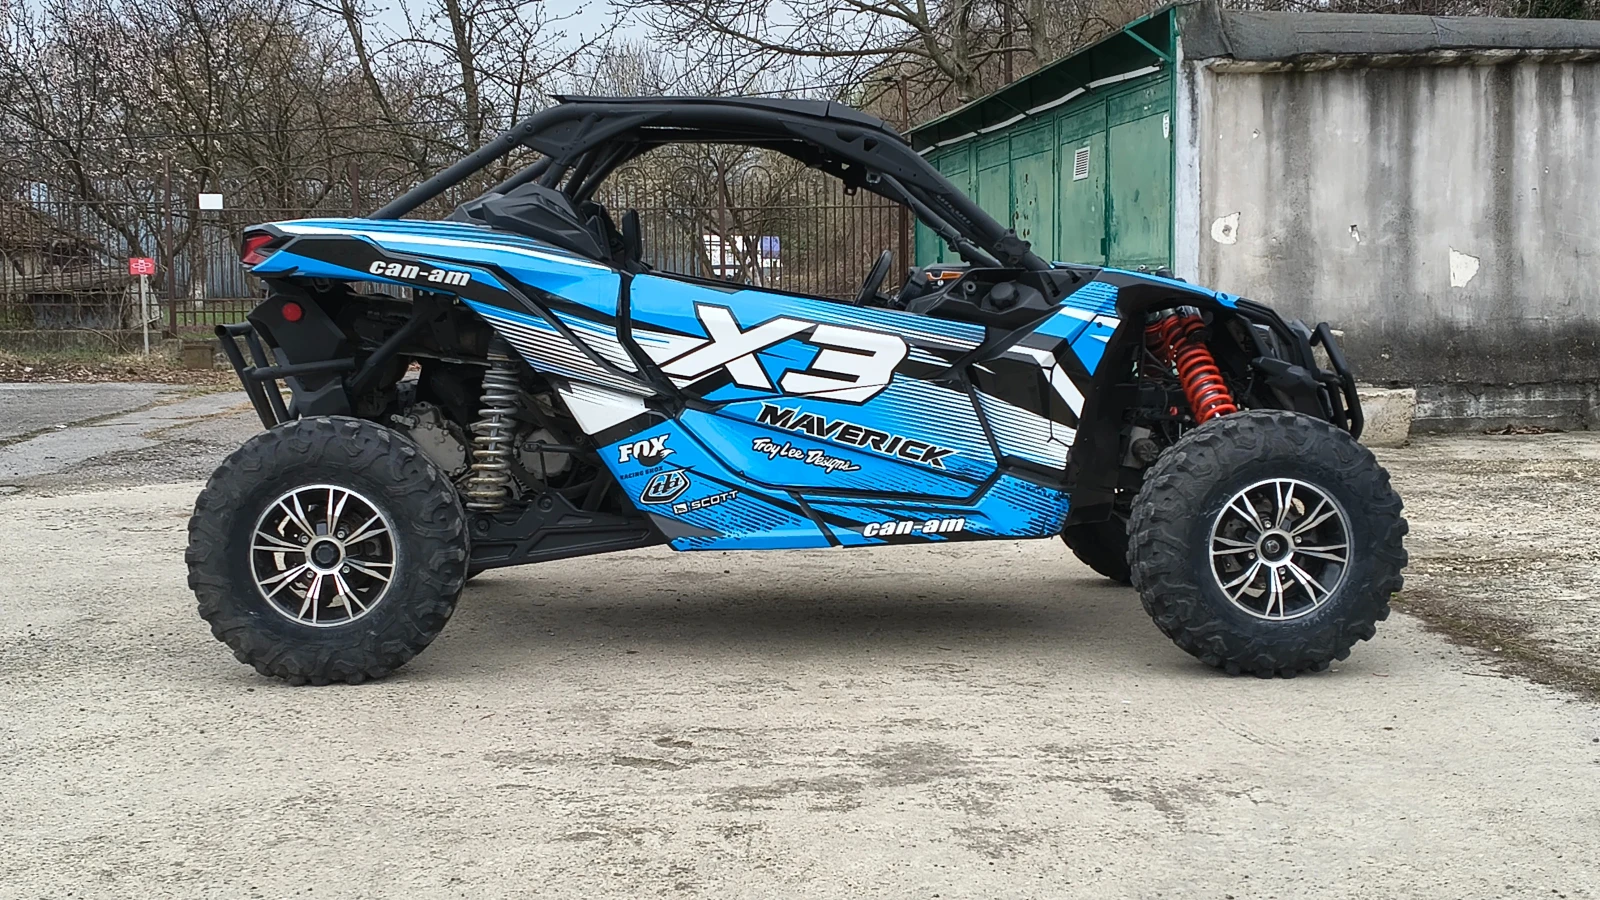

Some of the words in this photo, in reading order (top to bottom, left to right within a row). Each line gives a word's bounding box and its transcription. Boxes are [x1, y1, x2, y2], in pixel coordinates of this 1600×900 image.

[368, 260, 471, 287] can-am
[659, 302, 908, 404] X3
[618, 434, 674, 463] FOX
[755, 402, 957, 469] MAVERICK
[752, 438, 780, 460] Troy
[780, 442, 804, 459] Lee
[805, 450, 860, 474] Designs
[620, 470, 644, 480] RACING
[690, 489, 739, 510] SCOTT
[862, 517, 965, 538] can-am
